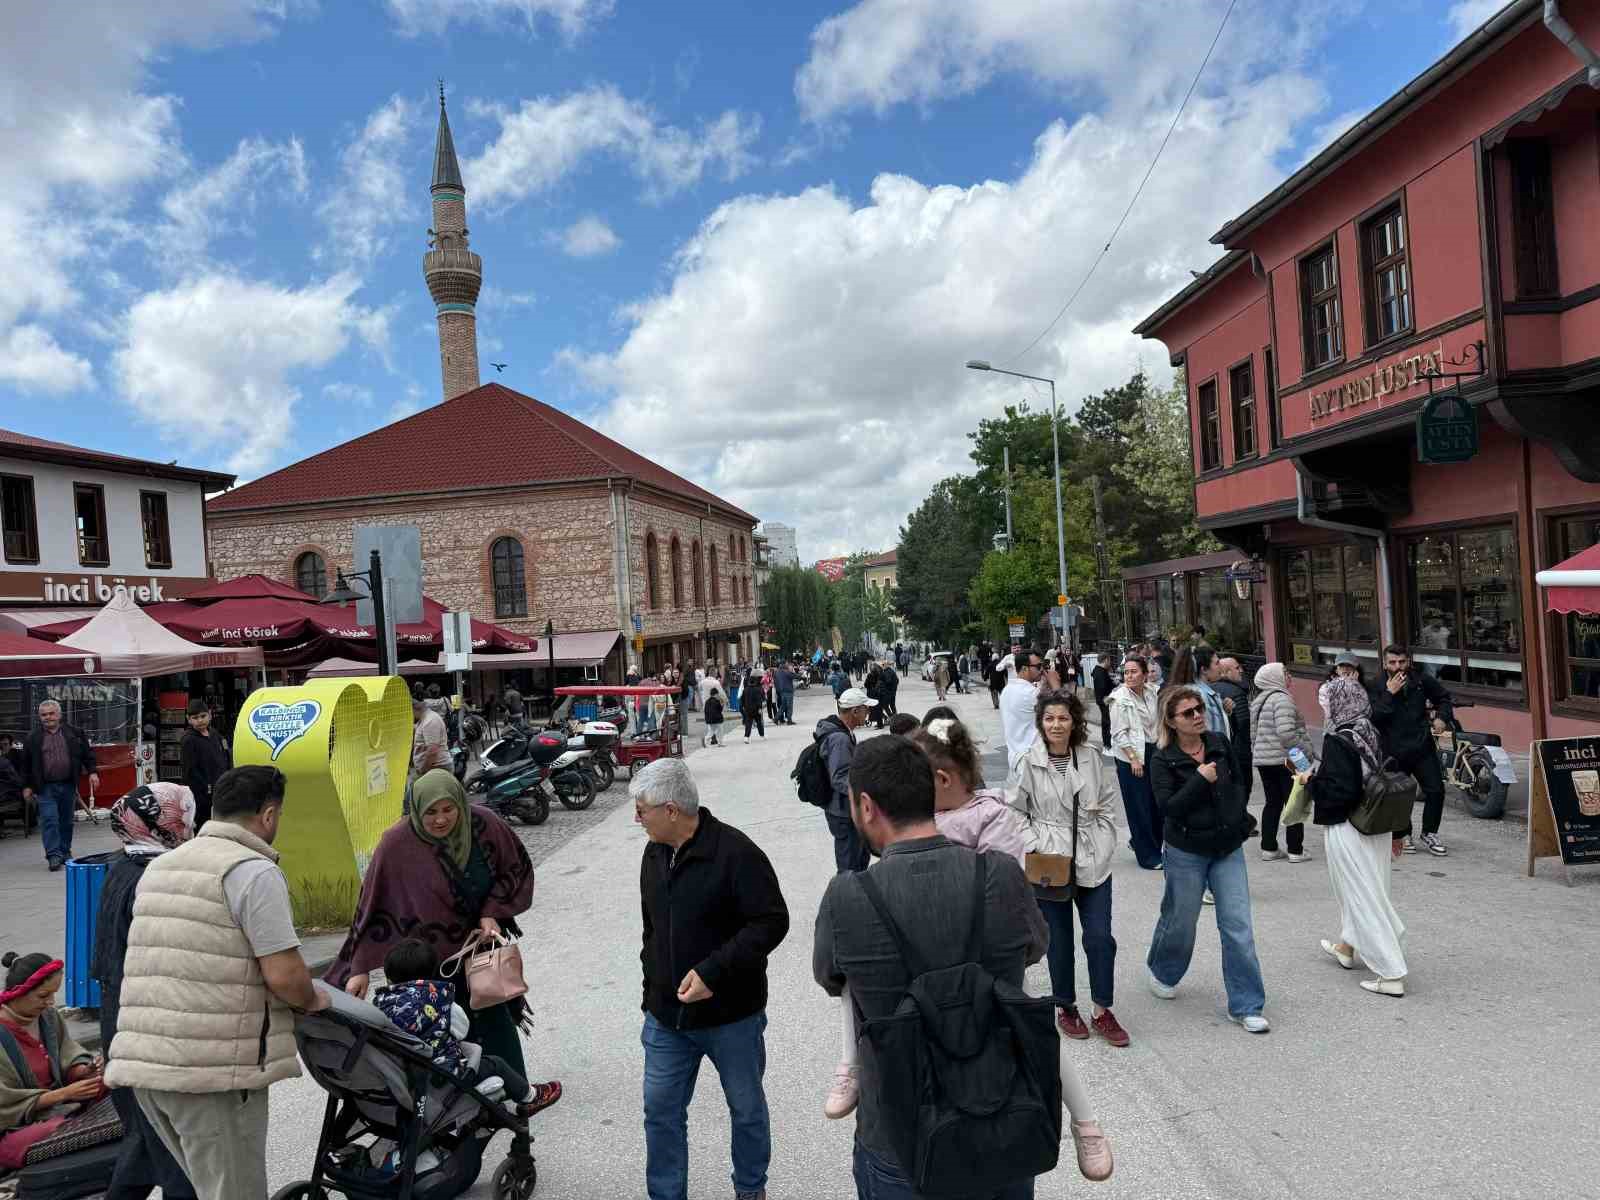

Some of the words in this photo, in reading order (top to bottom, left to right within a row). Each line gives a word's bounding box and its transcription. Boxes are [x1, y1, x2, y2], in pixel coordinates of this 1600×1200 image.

[1311, 374, 1376, 419] AYTEN
[1377, 349, 1441, 396] USTA
[44, 577, 89, 602] inci
[244, 624, 279, 638] börek
[1563, 744, 1597, 761] inci
